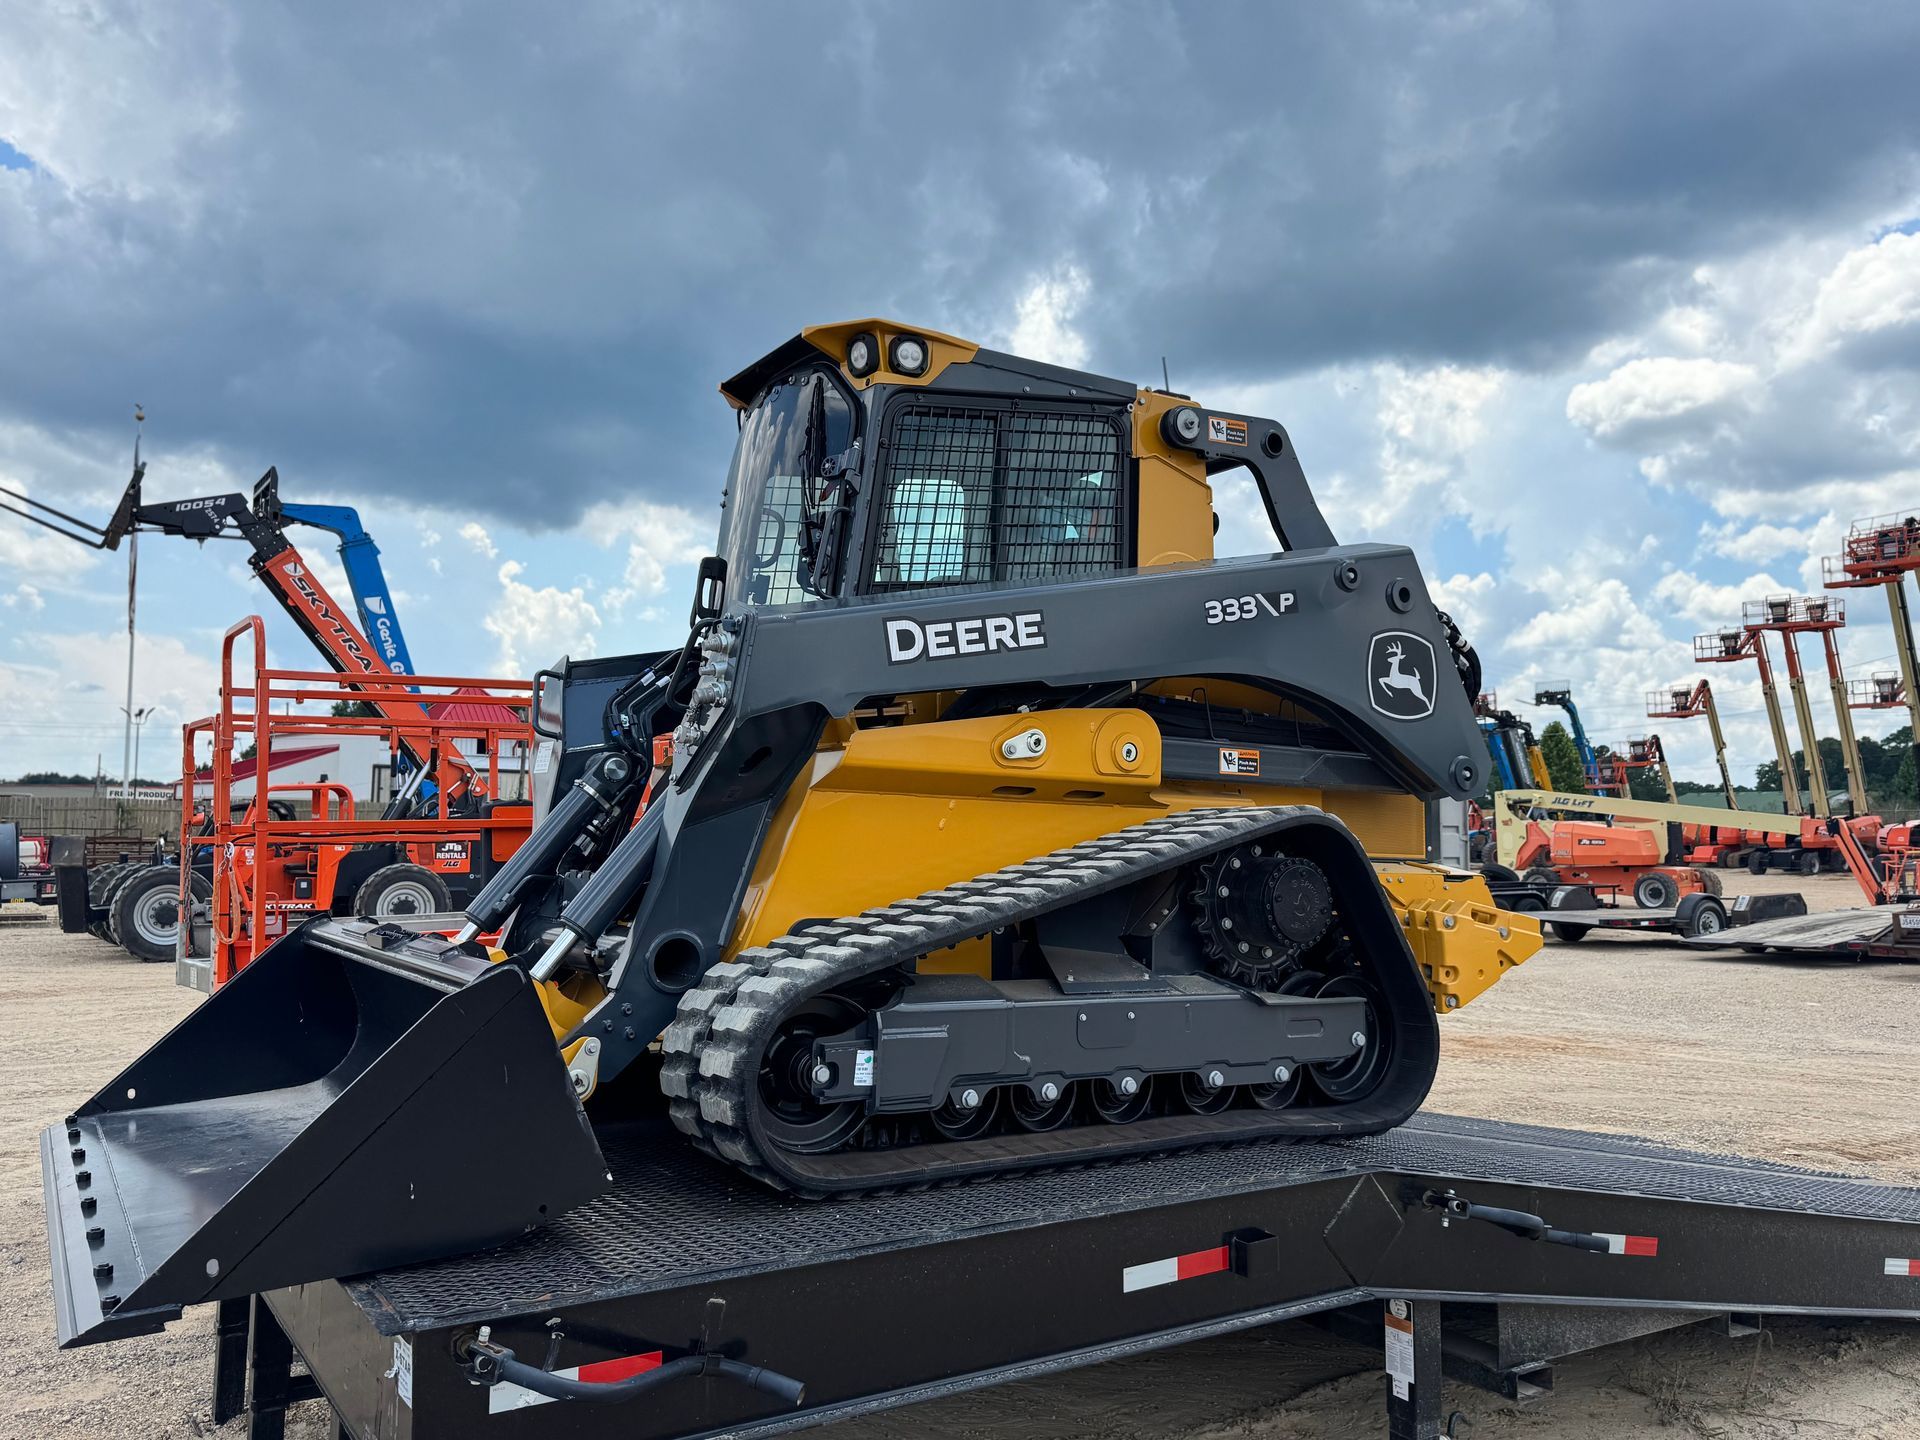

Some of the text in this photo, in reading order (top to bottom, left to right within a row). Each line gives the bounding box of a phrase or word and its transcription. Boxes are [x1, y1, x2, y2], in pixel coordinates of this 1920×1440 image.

[175, 497, 226, 512] 10054
[289, 576, 384, 680] SKYTRA
[376, 617, 397, 660] Genie
[886, 613, 1045, 662] DEERE
[1551, 796, 1570, 806] JLG
[441, 842, 462, 851] JTB
[442, 860, 461, 868] JLG
